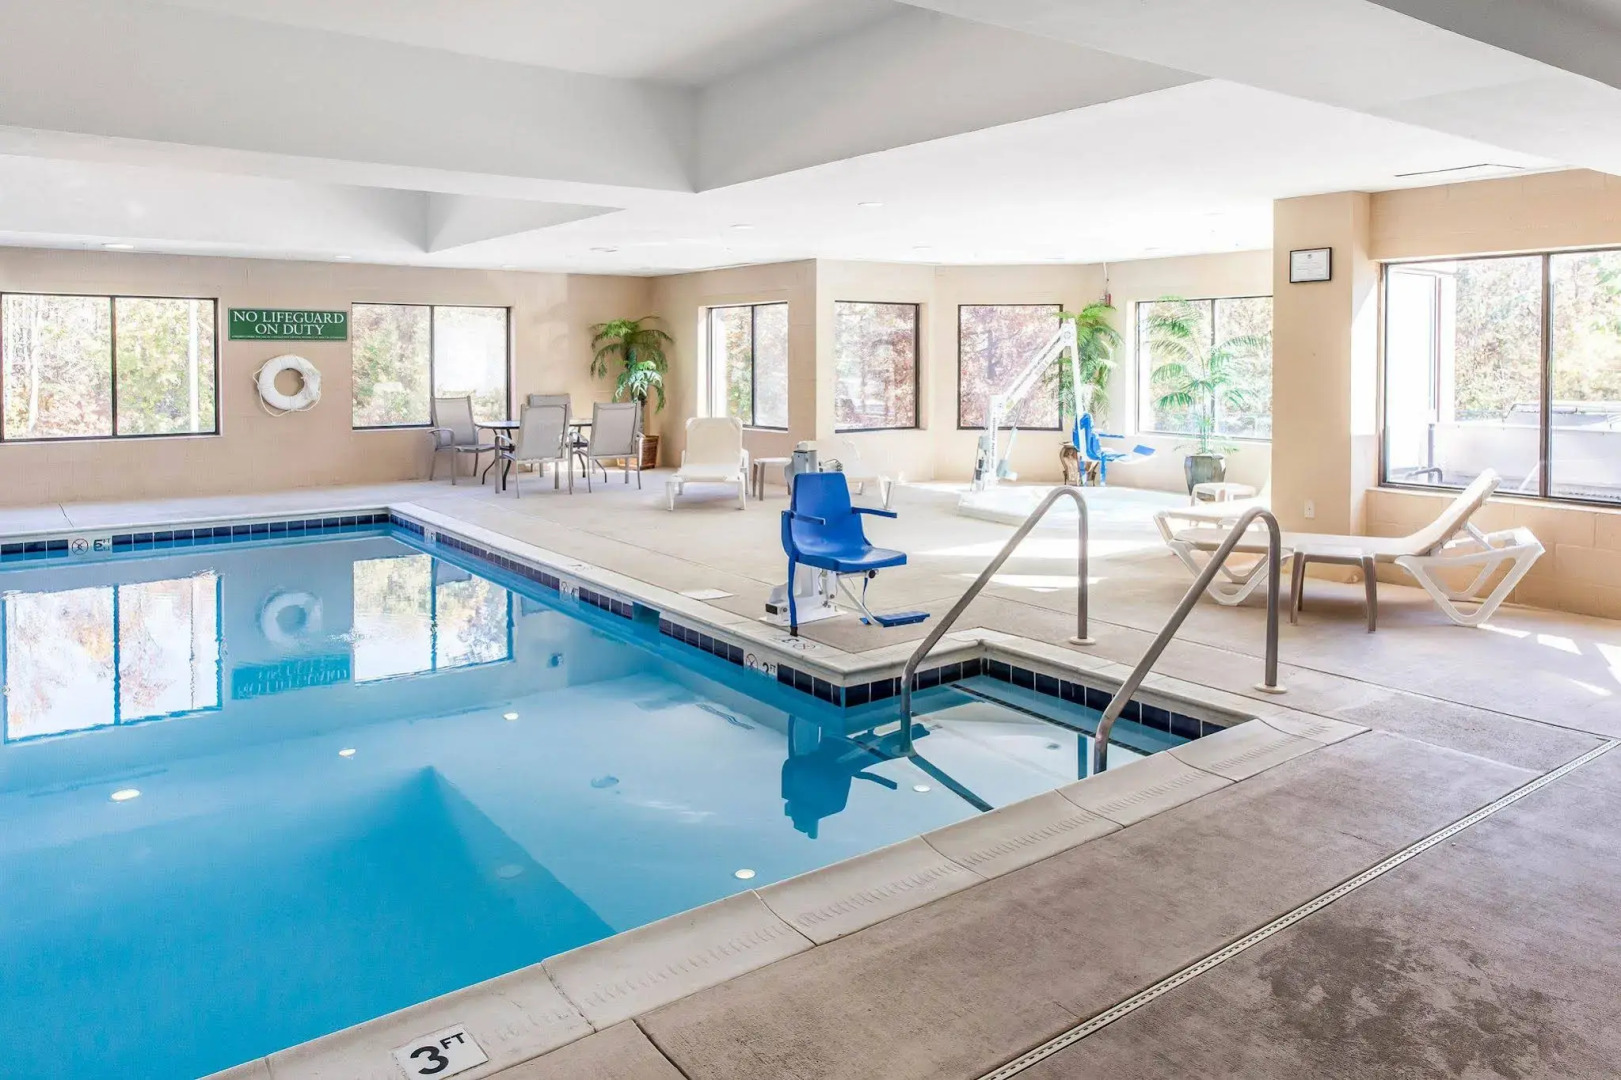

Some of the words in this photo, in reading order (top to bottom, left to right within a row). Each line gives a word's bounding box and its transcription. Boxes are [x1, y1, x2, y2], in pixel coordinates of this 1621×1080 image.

[233, 311, 258, 322] NO
[262, 311, 345, 324] LIFEGUARD
[255, 323, 278, 335] ON
[283, 324, 325, 335] DUTY
